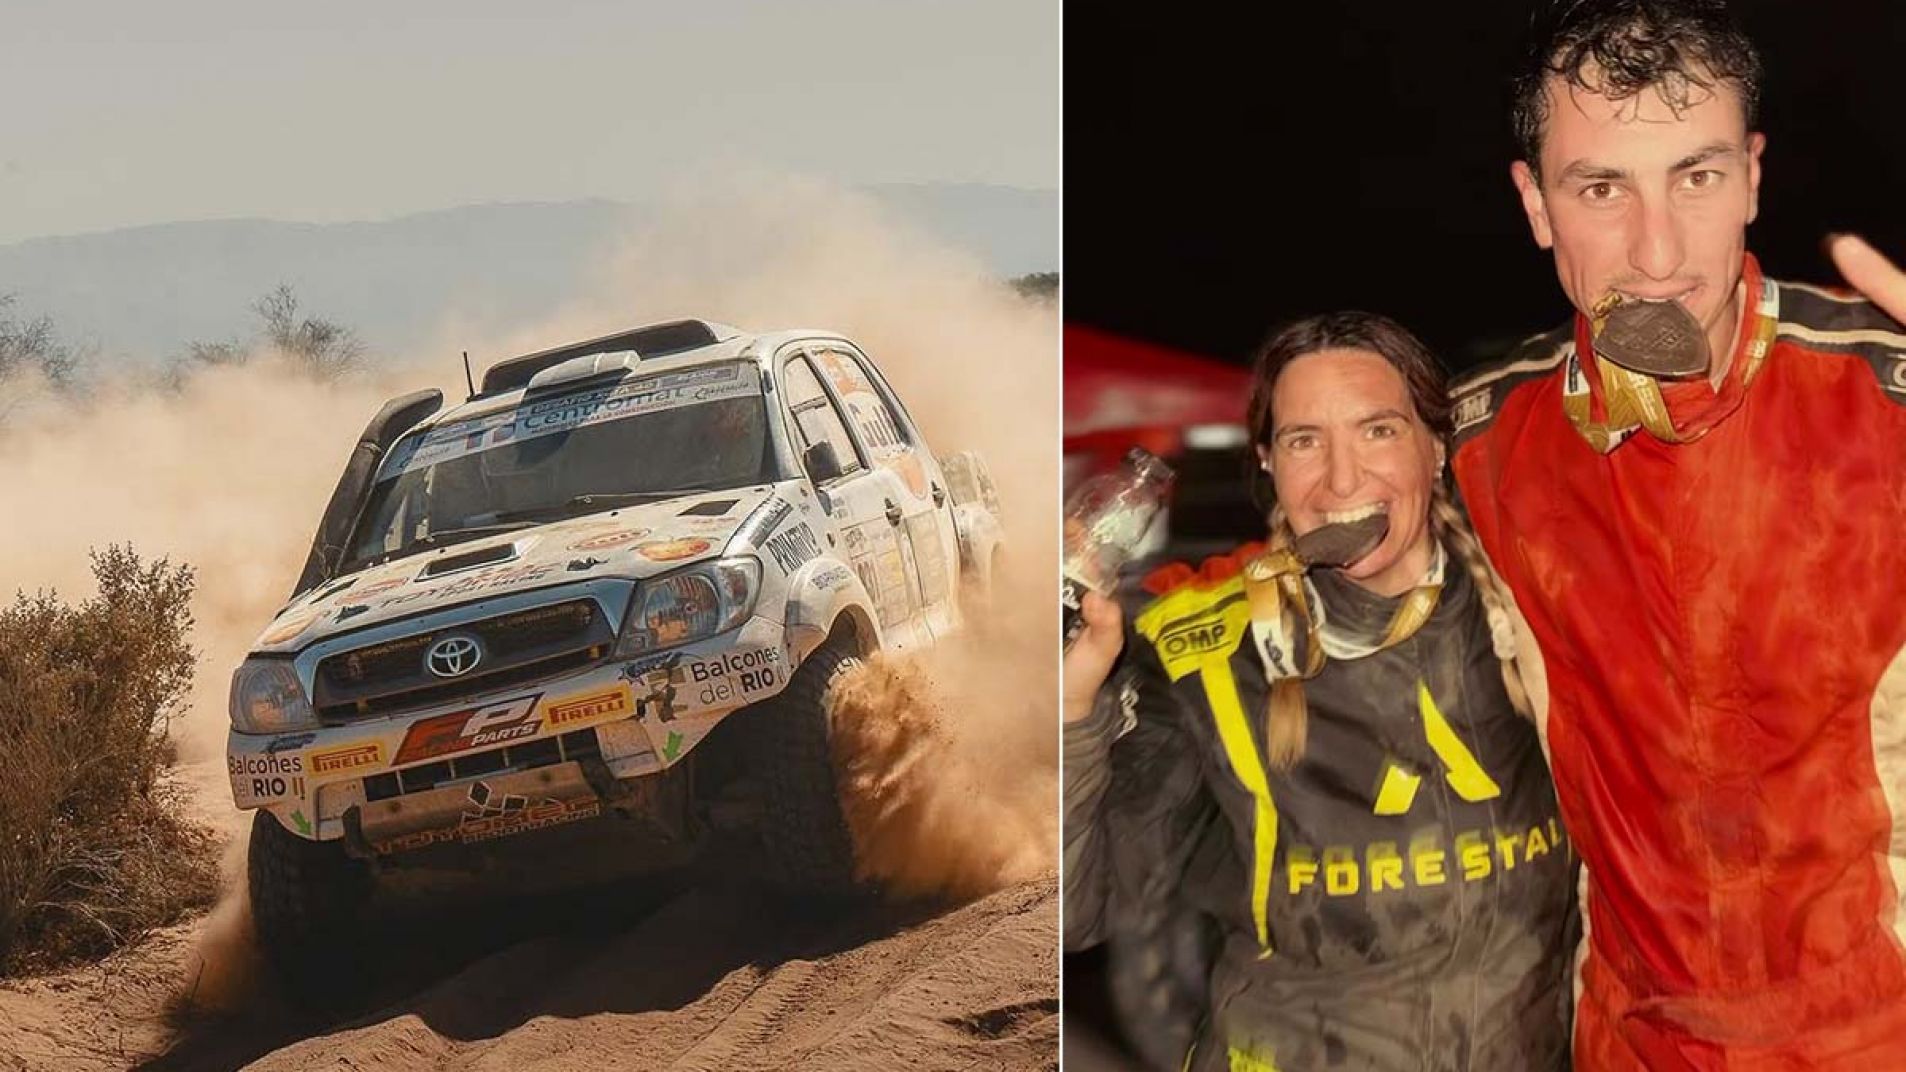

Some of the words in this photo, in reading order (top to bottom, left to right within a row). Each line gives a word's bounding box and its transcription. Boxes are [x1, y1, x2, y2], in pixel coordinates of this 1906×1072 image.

[1165, 624, 1226, 655] OMP
[690, 645, 780, 682] Balcones
[700, 677, 736, 705] del
[739, 667, 775, 693] RIO
[549, 691, 625, 724] PIRELLI
[471, 720, 536, 747] PARTS
[229, 754, 303, 775] Balcones
[311, 745, 379, 772] PIRELLI
[252, 777, 287, 798] RIO
[1288, 817, 1563, 896] FORESTAL
